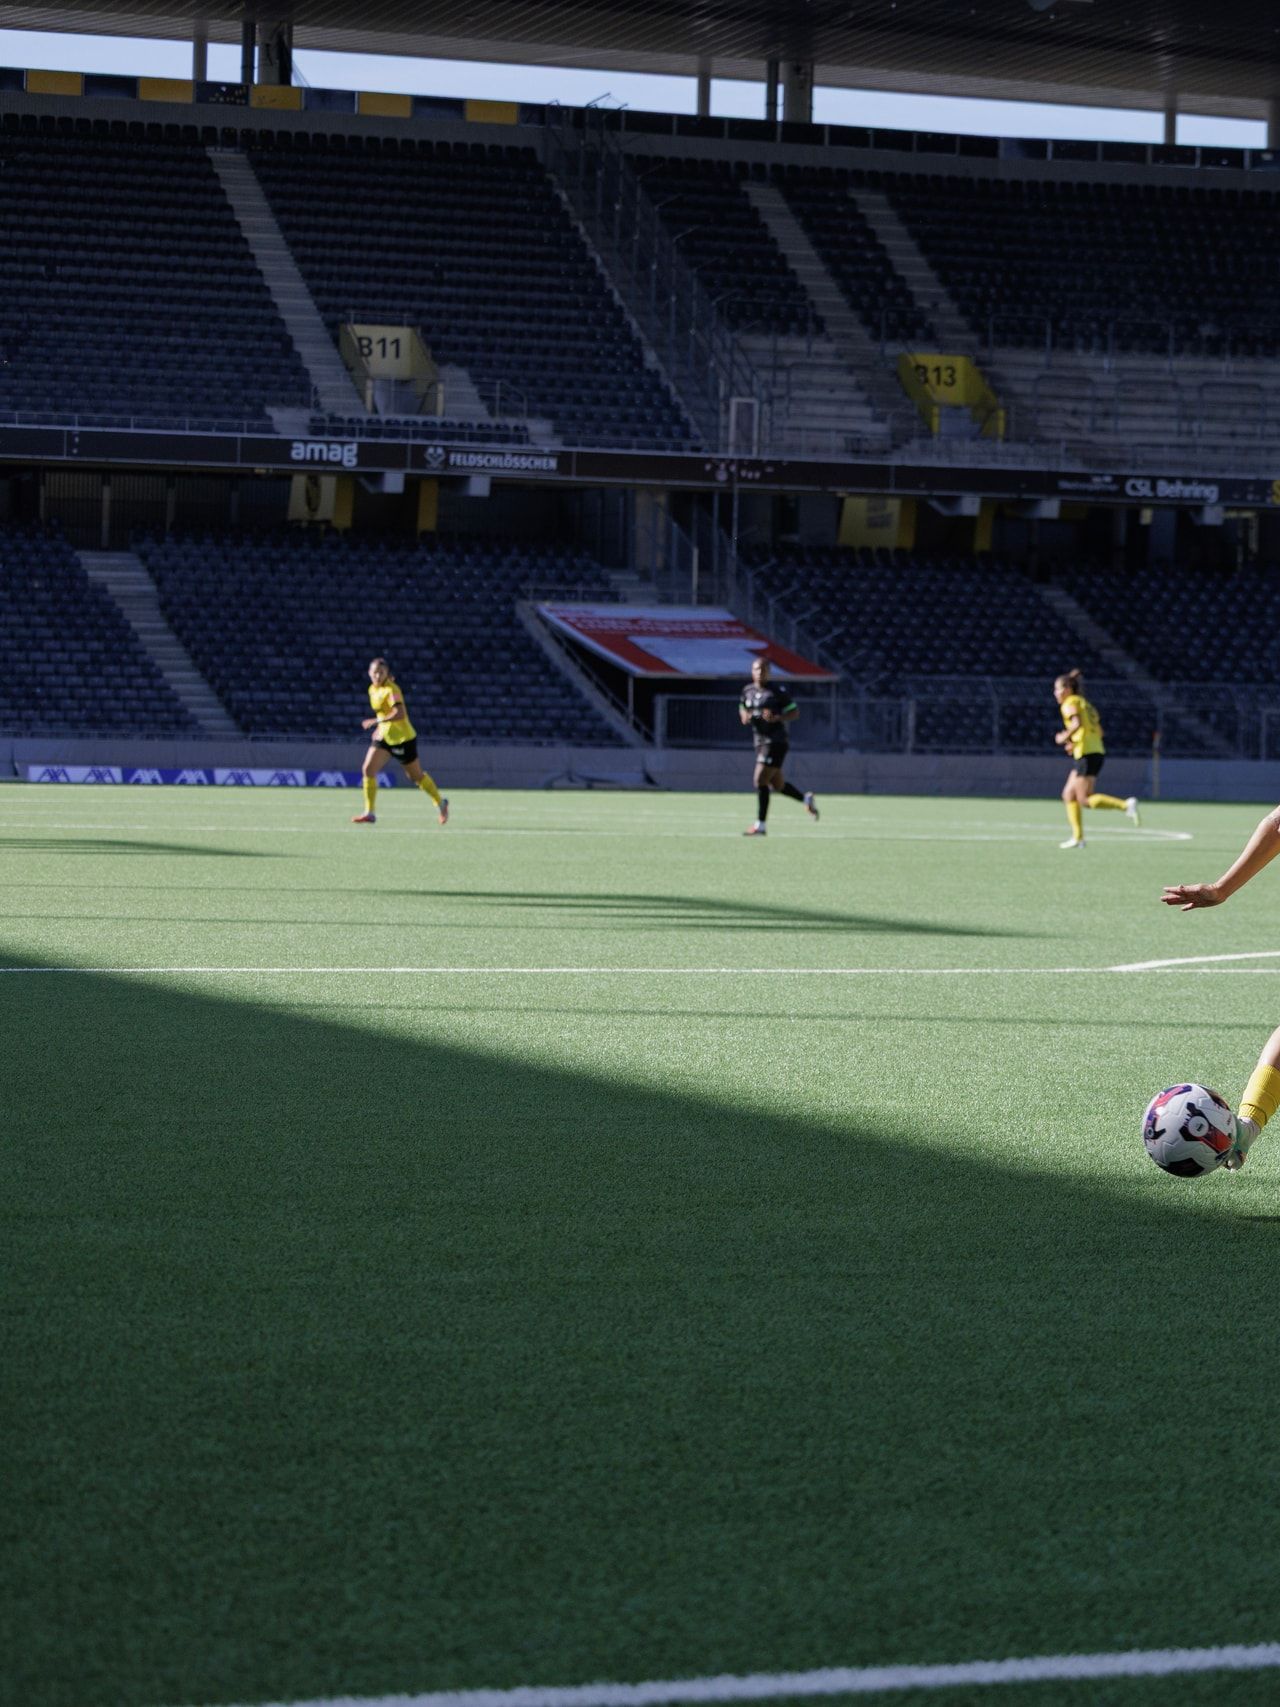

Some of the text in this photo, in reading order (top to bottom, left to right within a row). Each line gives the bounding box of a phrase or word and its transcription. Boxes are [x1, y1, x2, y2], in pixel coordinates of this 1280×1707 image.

[357, 336, 401, 359] B11
[290, 442, 358, 467] amag
[449, 453, 557, 471] FELDSCHLÖSSCHEN
[1156, 478, 1219, 503] Behring
